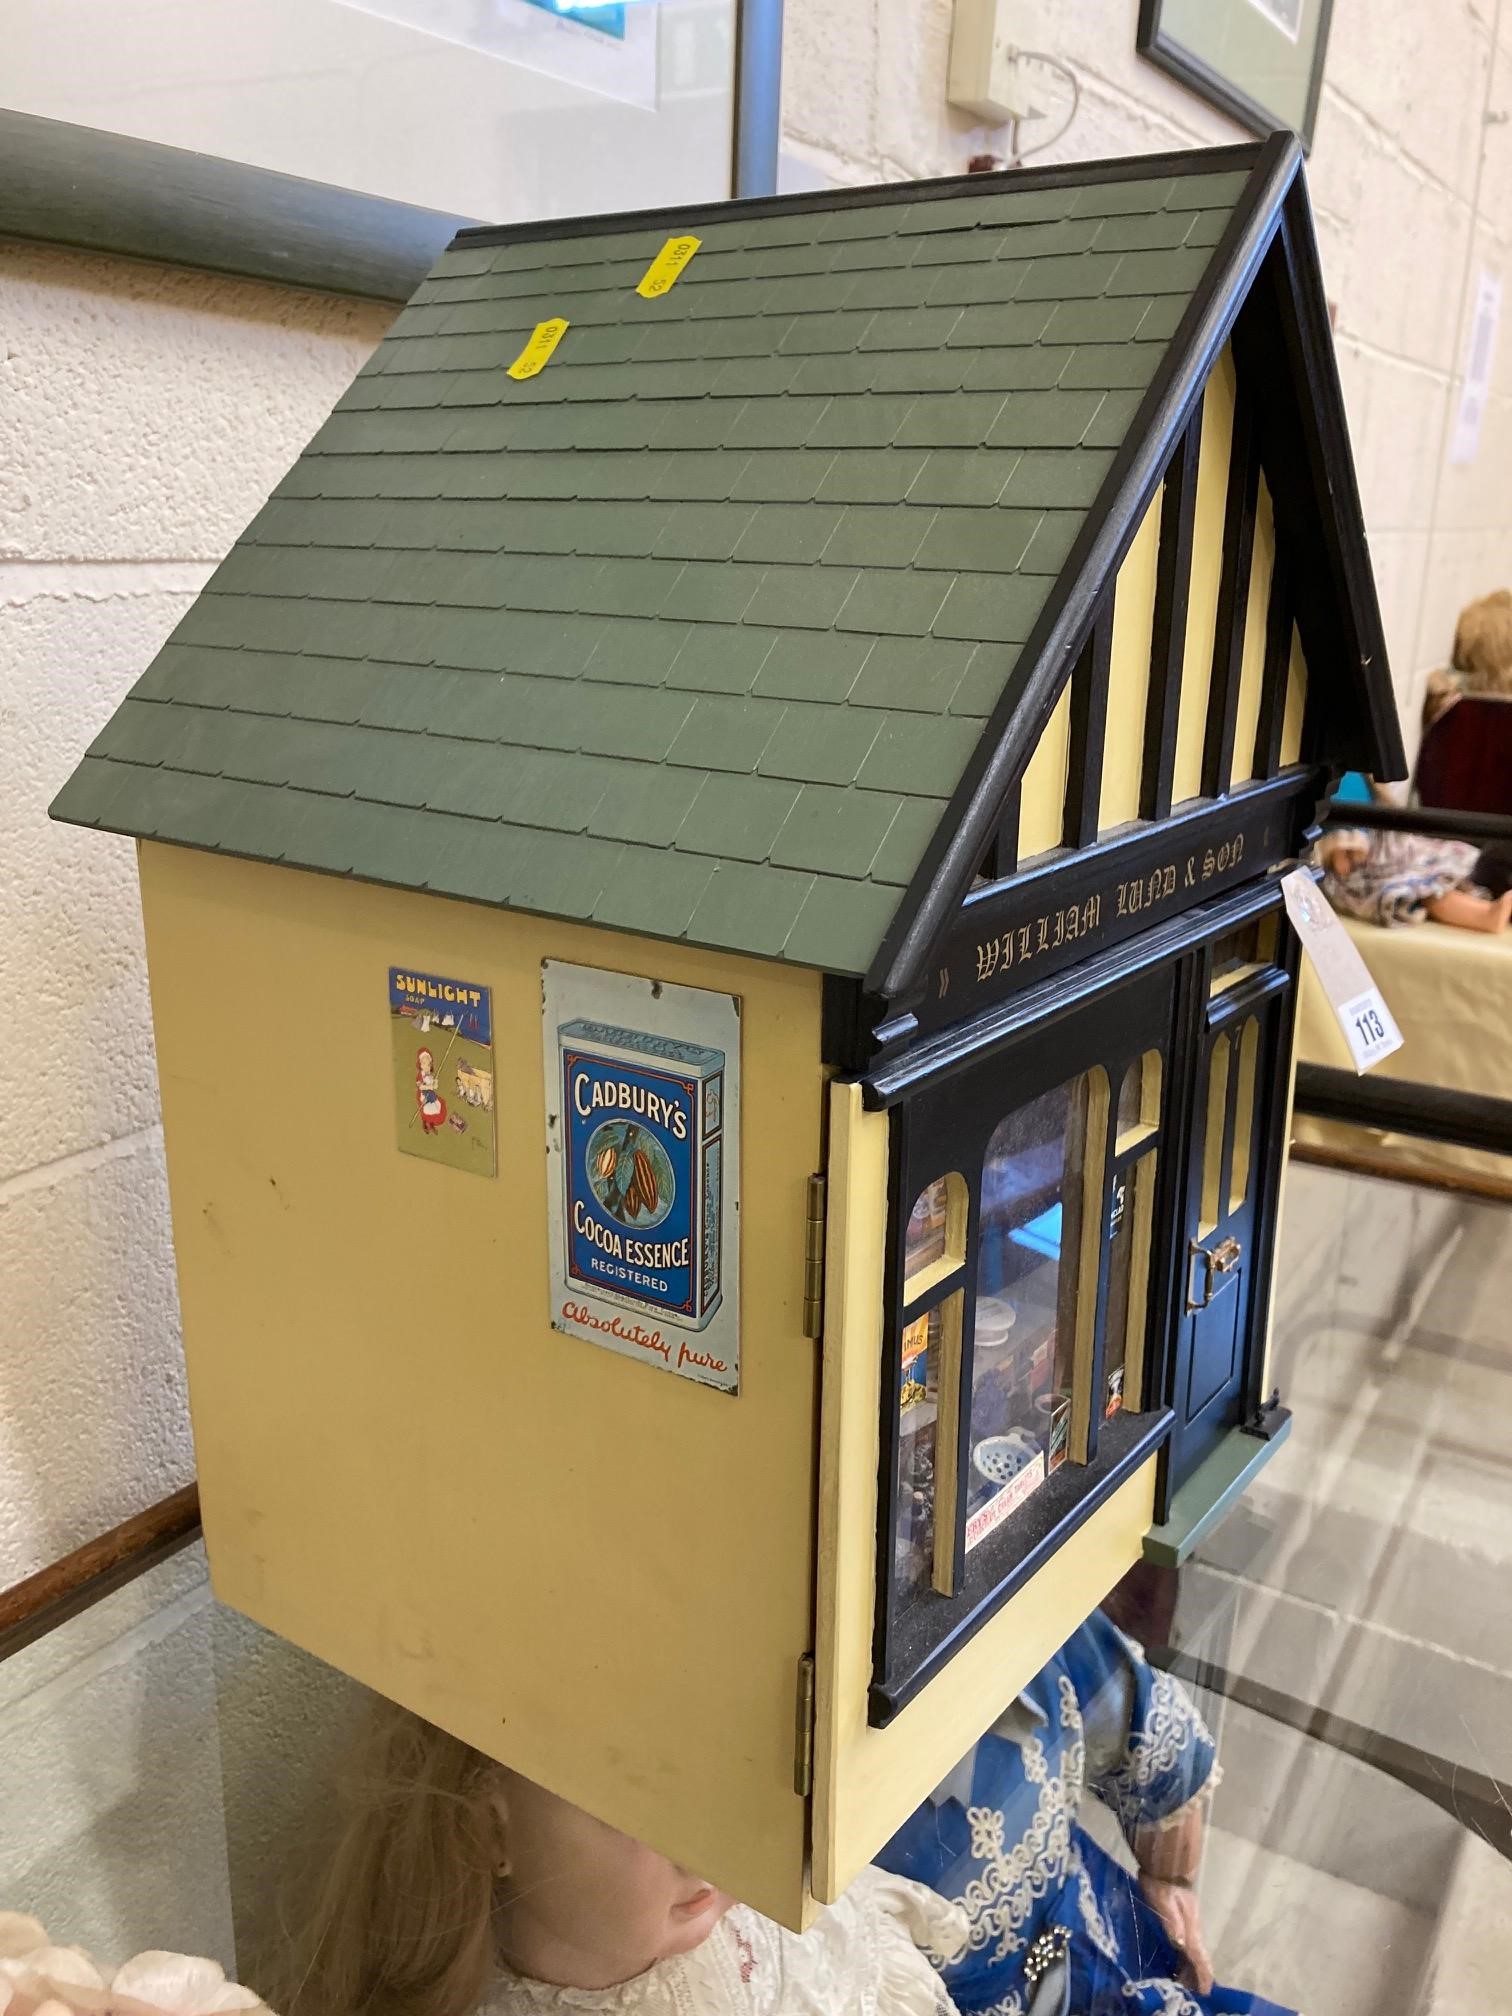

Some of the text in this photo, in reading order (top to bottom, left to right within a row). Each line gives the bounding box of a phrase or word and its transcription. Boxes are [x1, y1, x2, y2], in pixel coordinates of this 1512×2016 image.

[976, 833, 1245, 983] WILLIAM LUND & SON
[396, 974, 481, 1008] SUNLIGHT
[1355, 1009, 1385, 1046] 113
[574, 1073, 687, 1139] CADBURY'S
[574, 1200, 690, 1268] COCOA ESSENCE
[591, 1258, 669, 1292] REGISTERED
[677, 1342, 728, 1372] pure
